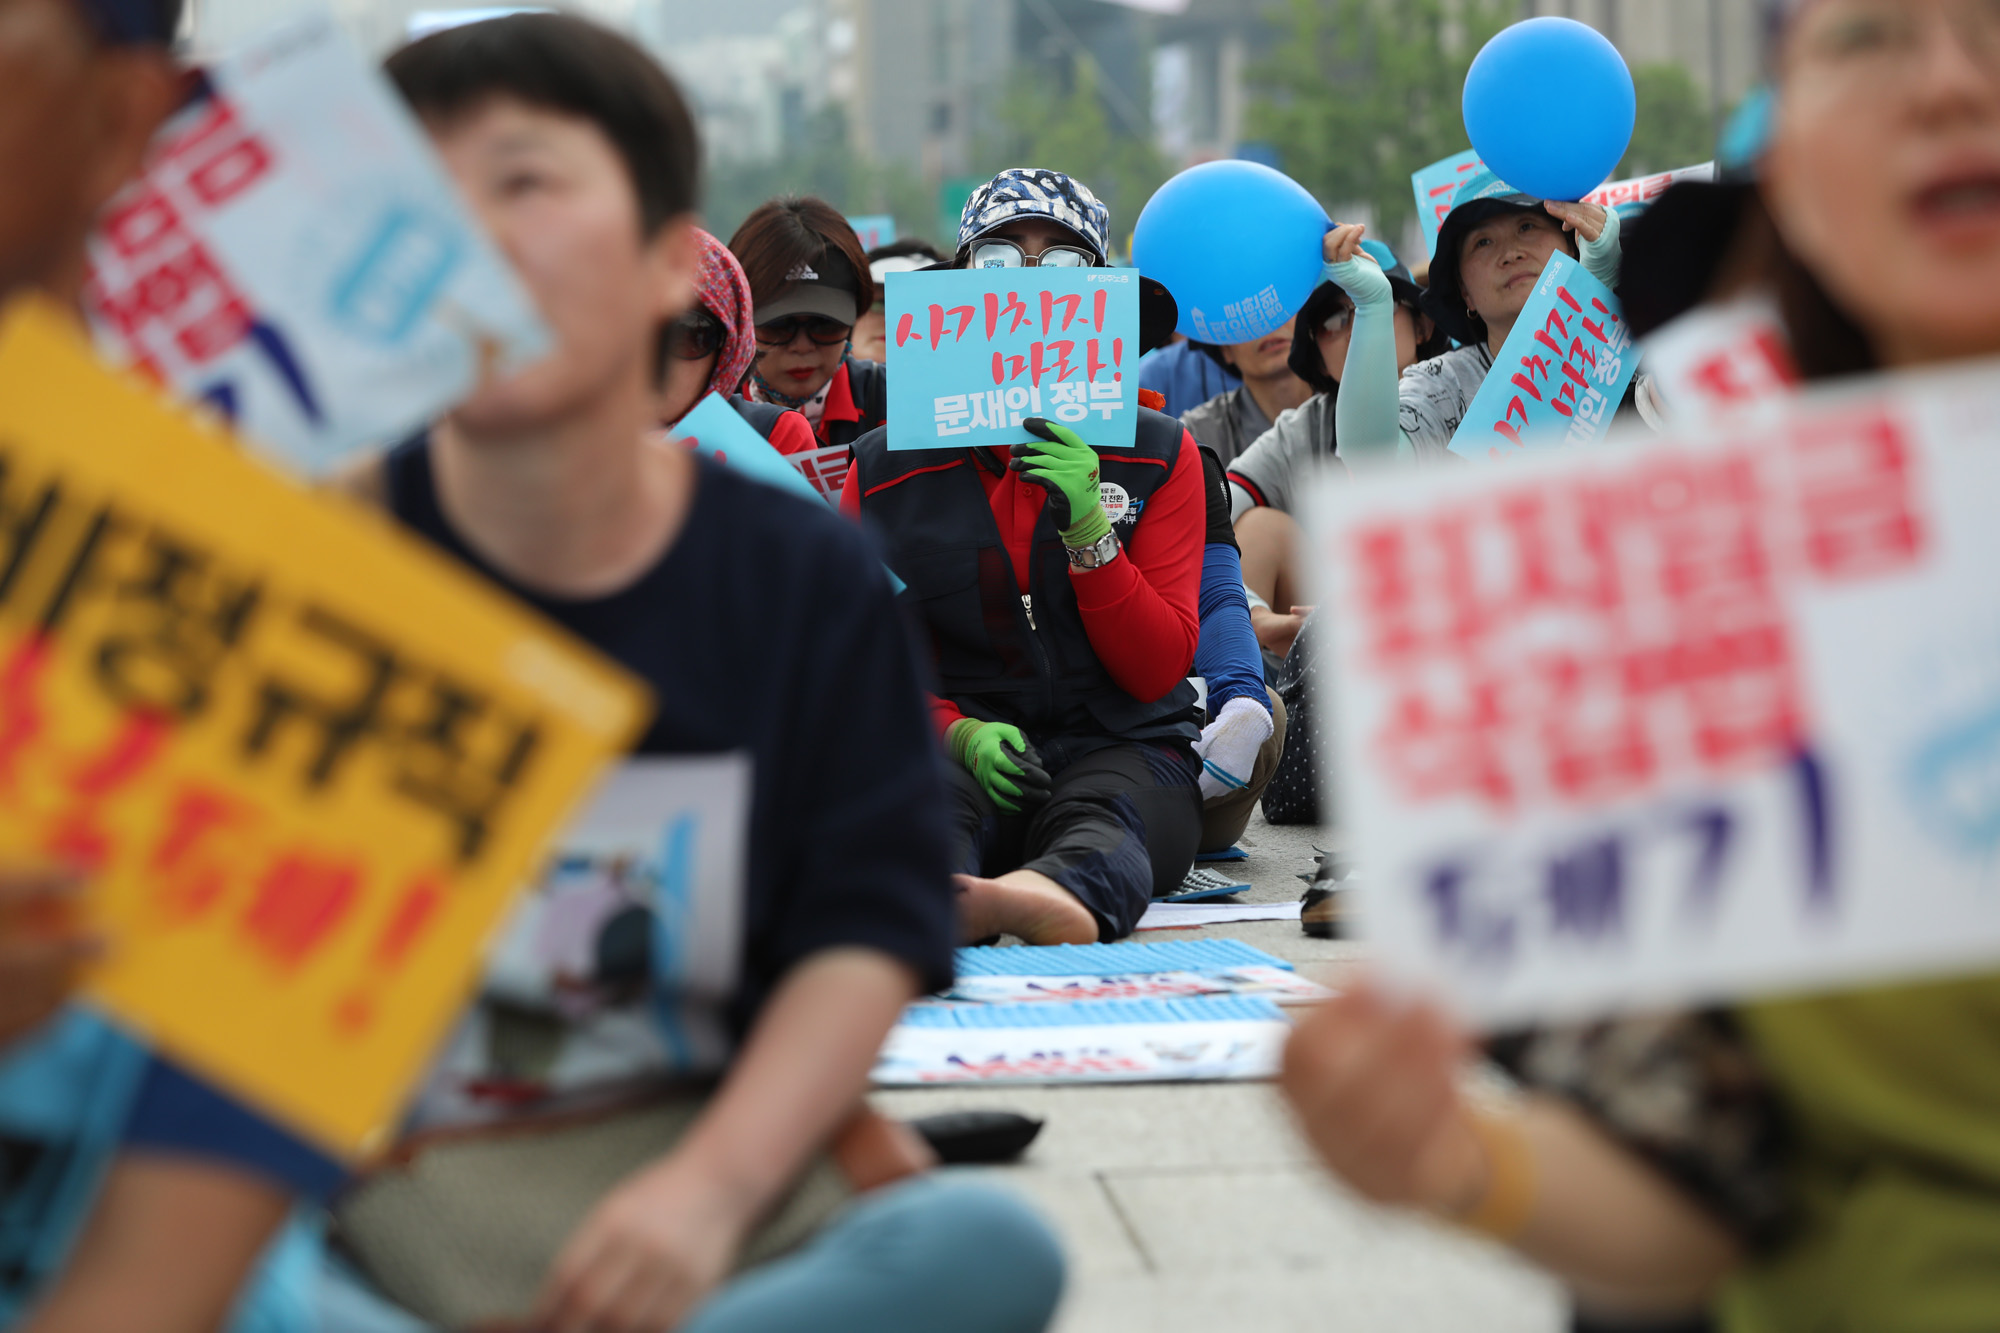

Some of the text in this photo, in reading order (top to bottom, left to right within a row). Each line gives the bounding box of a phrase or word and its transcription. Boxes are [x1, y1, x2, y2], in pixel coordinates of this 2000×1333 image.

[895, 289, 1107, 351] 사기치지
[991, 337, 1123, 388] 마라!
[1551, 297, 1619, 417] 마라!
[934, 380, 1124, 437] 문재인 정부
